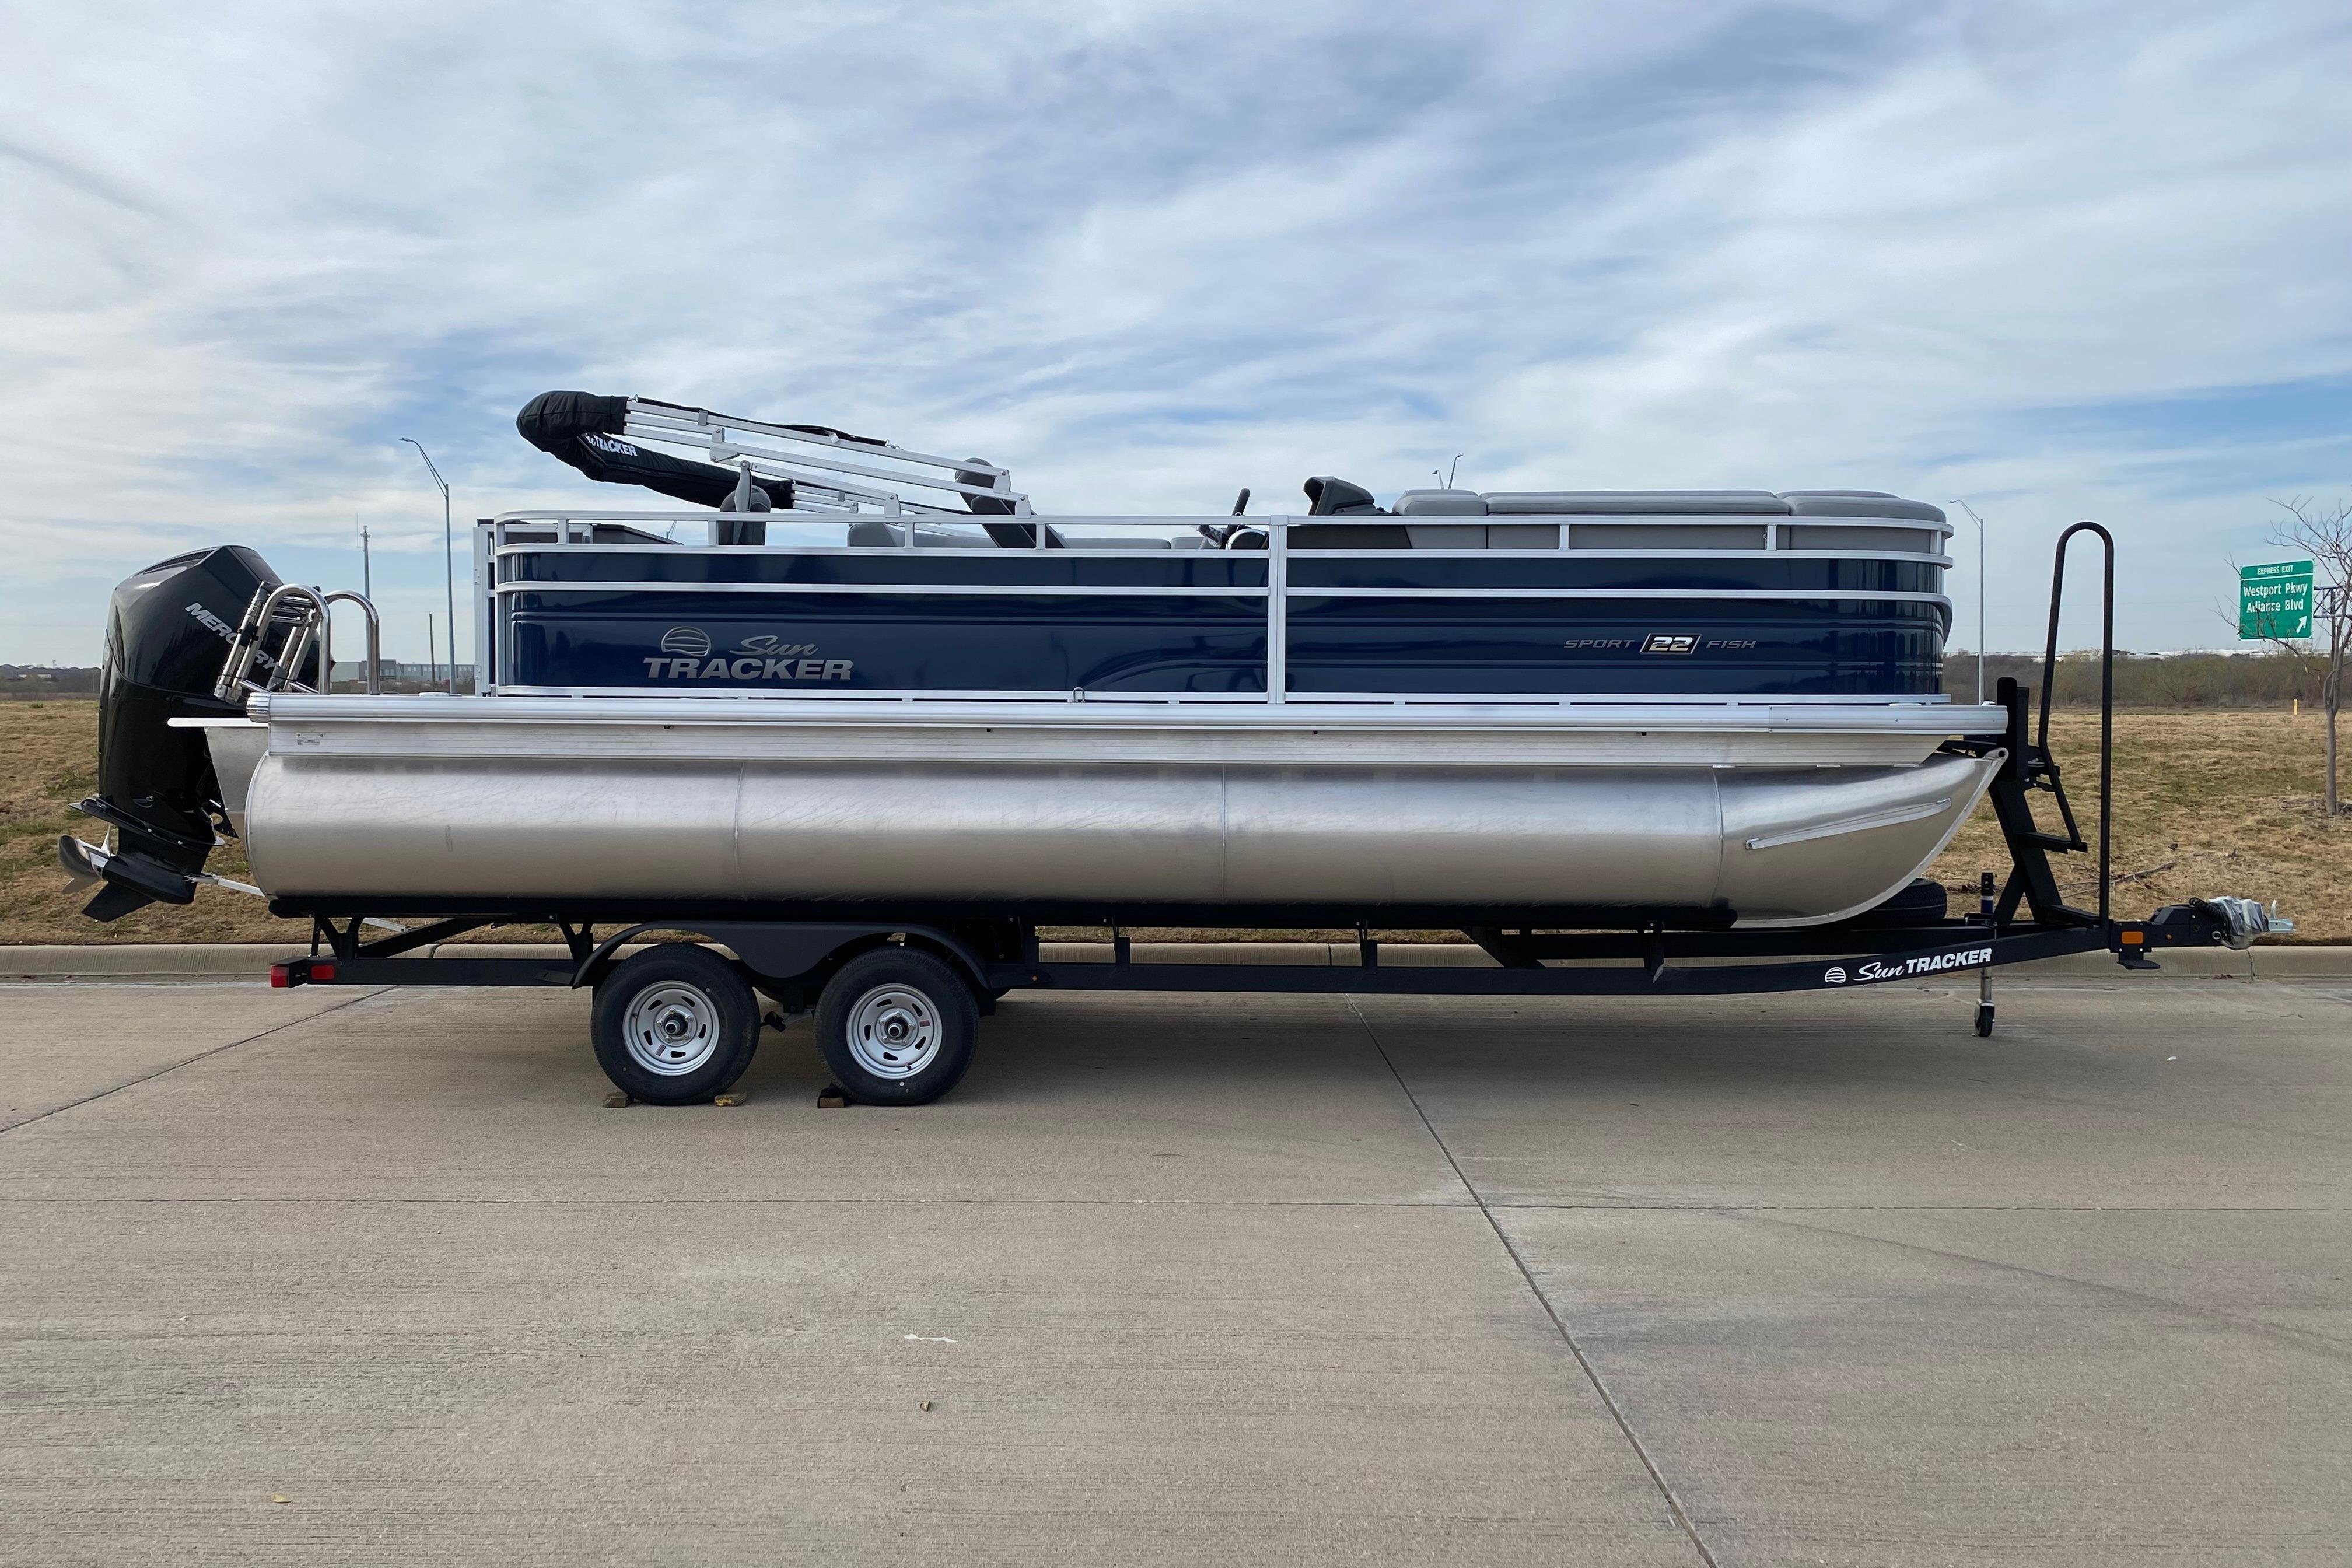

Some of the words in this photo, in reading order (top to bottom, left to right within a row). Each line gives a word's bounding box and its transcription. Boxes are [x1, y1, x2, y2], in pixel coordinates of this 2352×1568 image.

[2257, 566, 2280, 575] EXPRESS
[2244, 583, 2281, 598] Westport
[2285, 582, 2308, 596] Pkwy
[2285, 598, 2304, 611] Blvd
[184, 602, 276, 669] MERCRY
[1563, 639, 1636, 649] SPORT
[1648, 636, 1693, 652] 22
[1705, 640, 1757, 649] FISH
[729, 635, 820, 657] Sun
[643, 657, 854, 680] TRACKER
[1852, 962, 1905, 981] Sun
[1906, 948, 1993, 974] TRACKER
